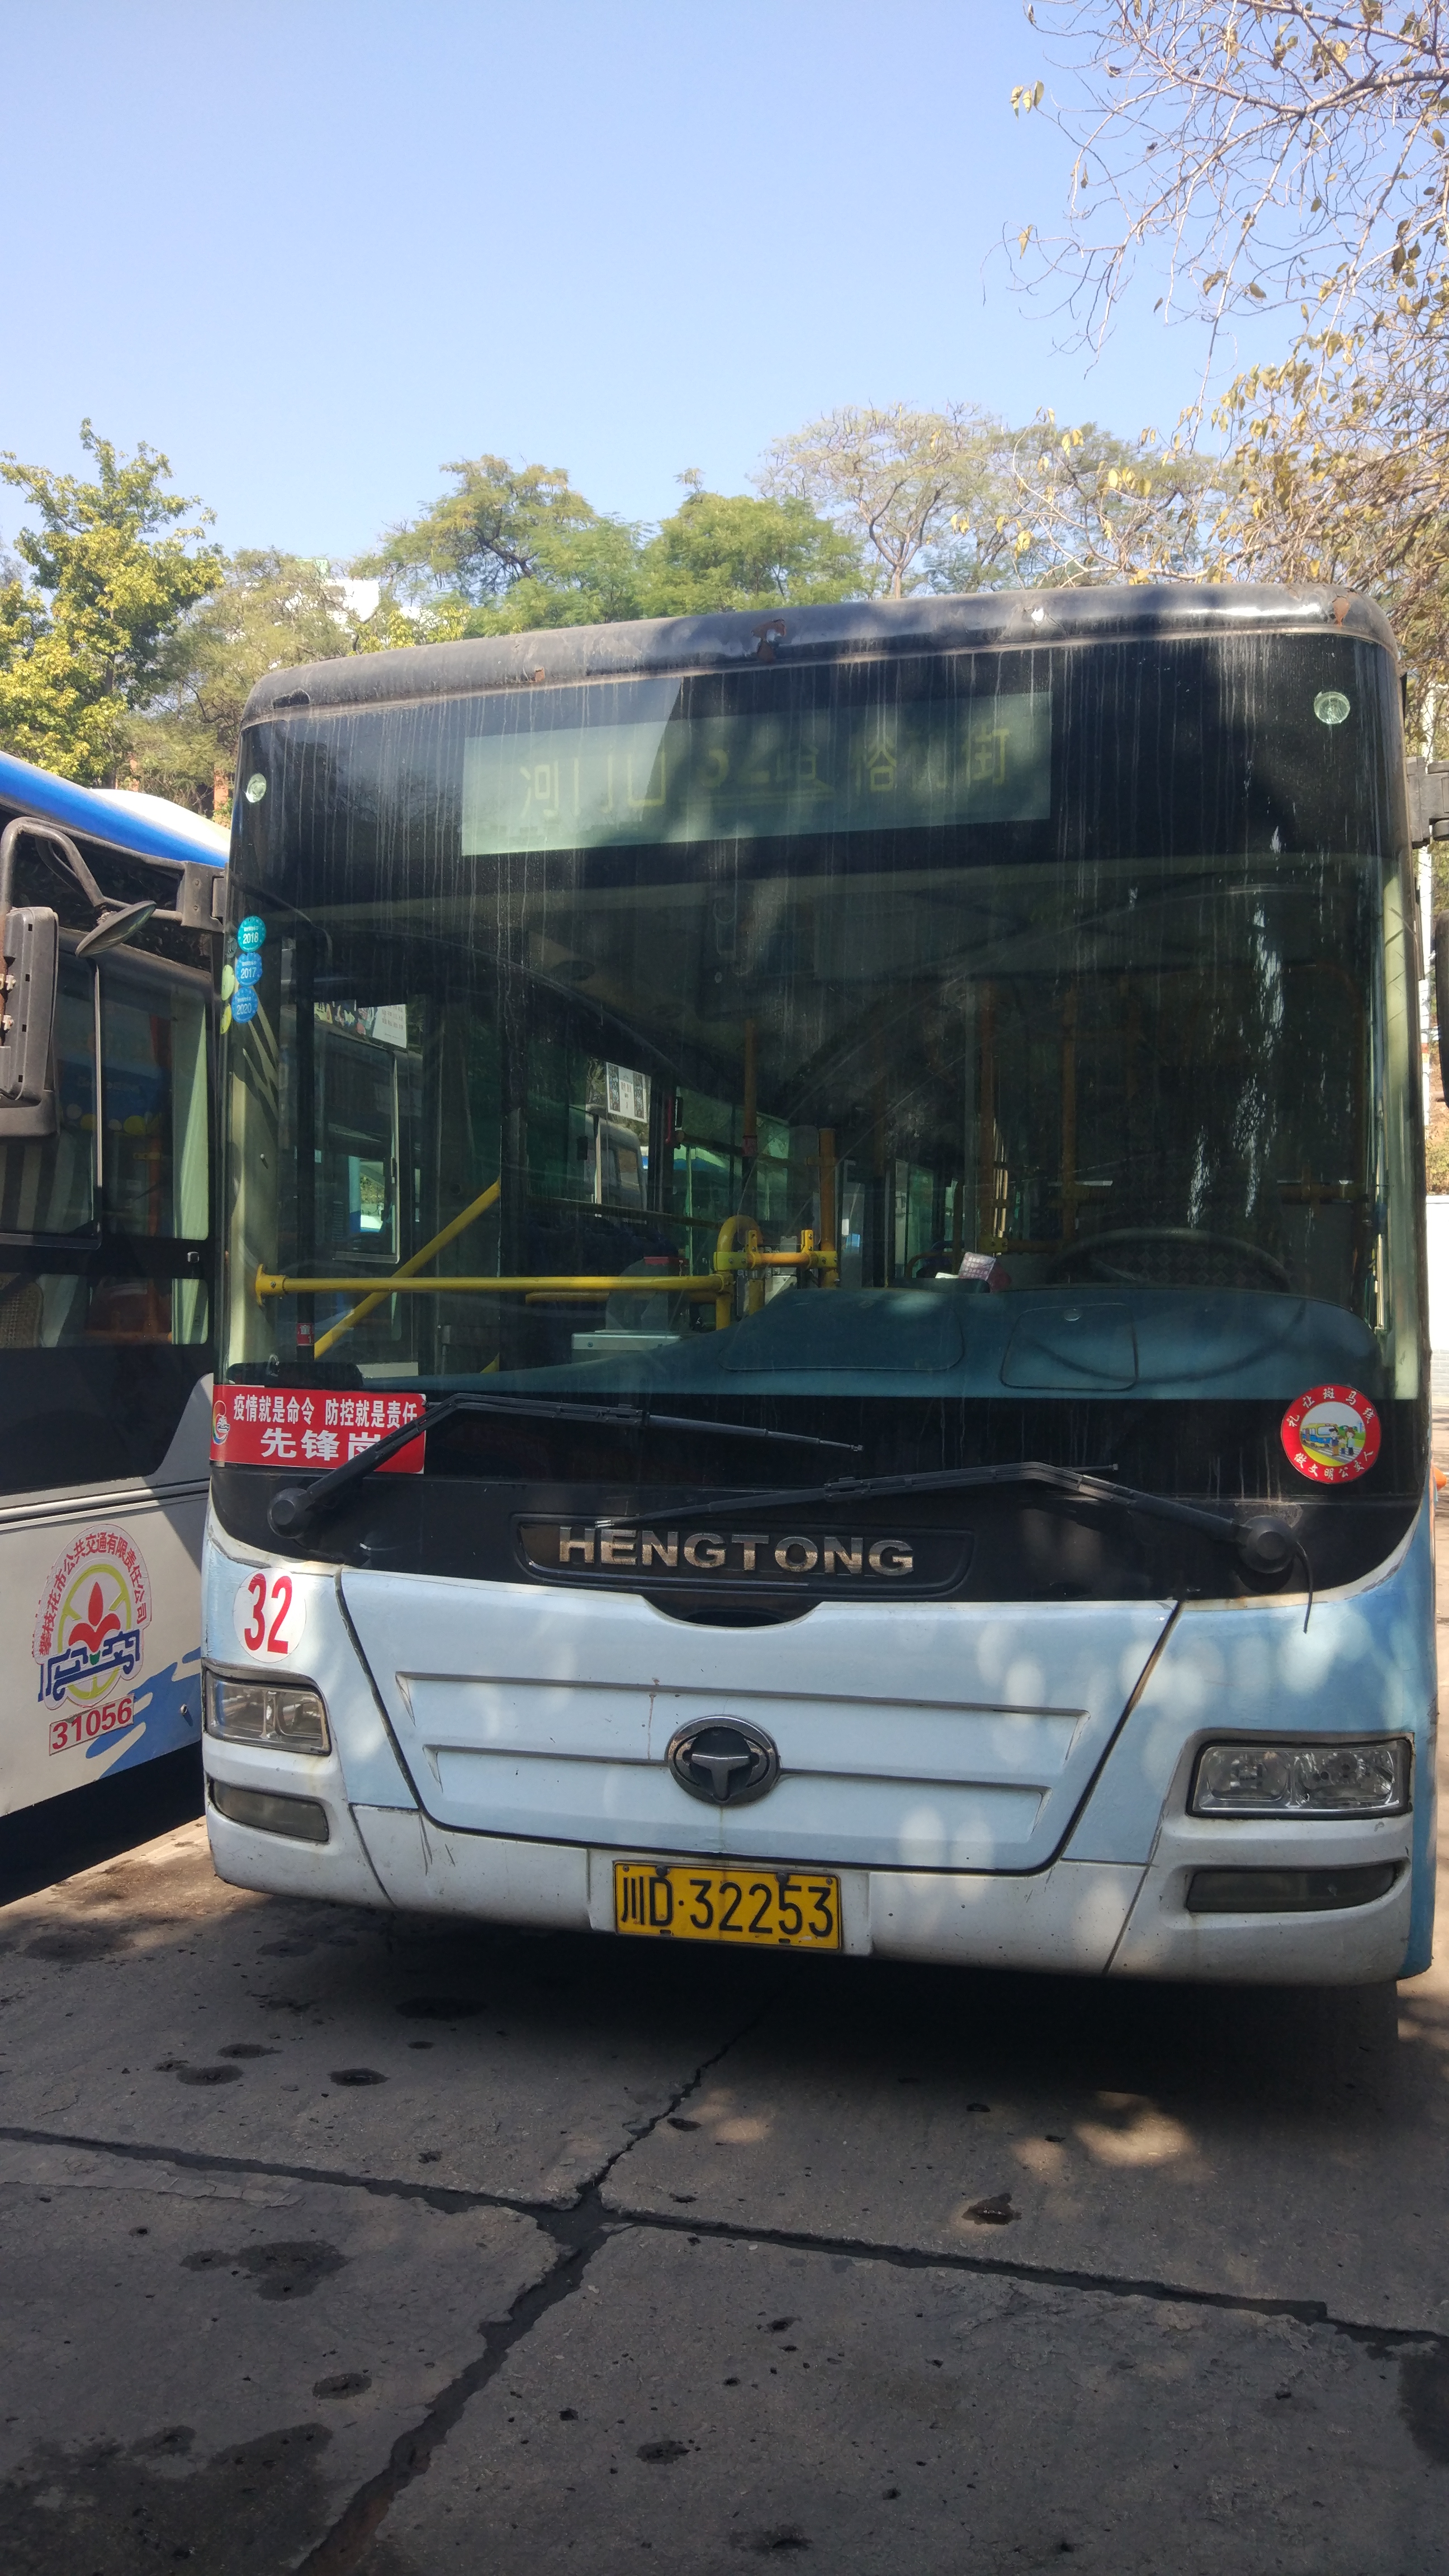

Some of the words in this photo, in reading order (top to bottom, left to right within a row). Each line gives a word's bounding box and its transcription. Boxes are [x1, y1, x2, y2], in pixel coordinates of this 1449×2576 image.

[243, 931, 259, 944] 2018
[240, 967, 257, 979] 2017
[236, 1003, 252, 1015] 2020
[234, 1394, 314, 1425] 疫情就是命令
[325, 1398, 418, 1429] 防控就是责任
[1286, 1388, 1375, 1427] 礼让斑马线
[1294, 1451, 1374, 1481] 做文明公交人
[560, 1526, 913, 1576] HENGTONG
[39, 1532, 148, 1656] 攀枝花市公共交通有限责任公司
[244, 1573, 292, 1655] 32
[52, 1697, 132, 1750] 31056
